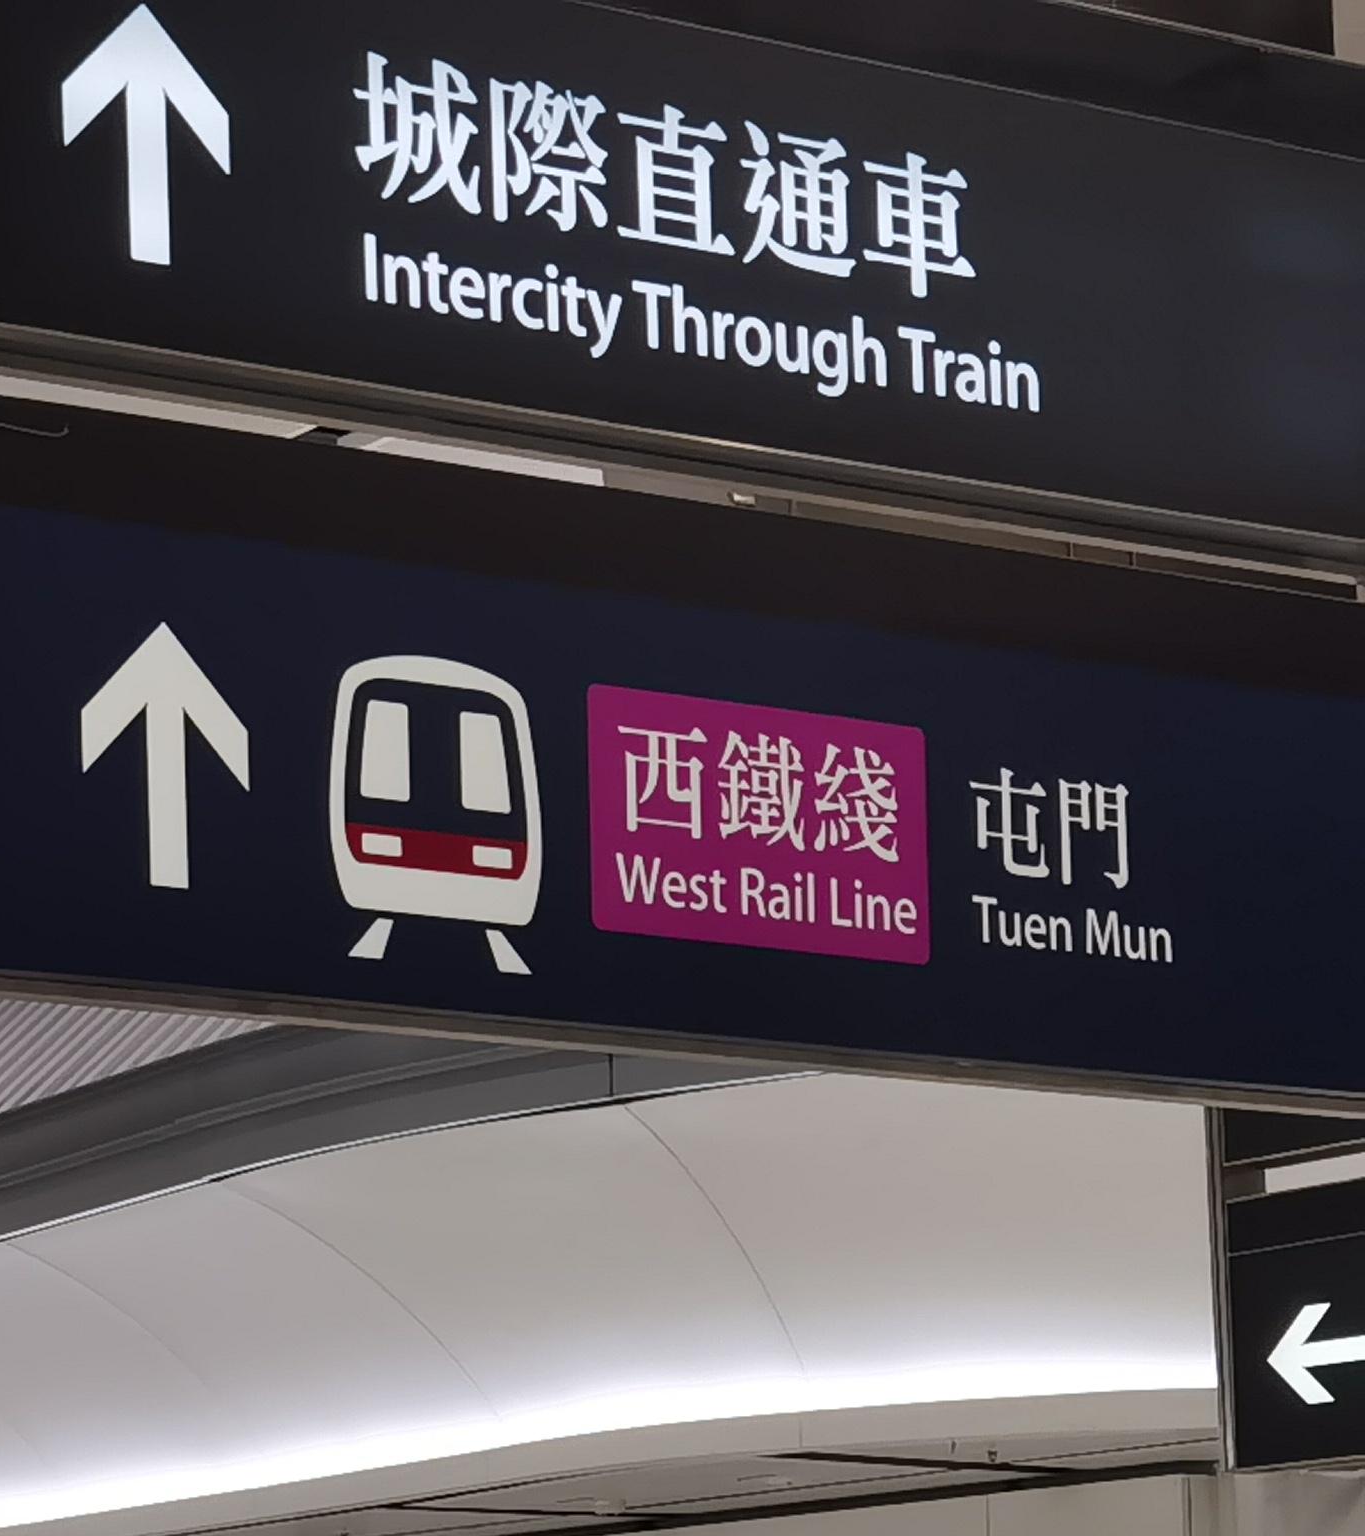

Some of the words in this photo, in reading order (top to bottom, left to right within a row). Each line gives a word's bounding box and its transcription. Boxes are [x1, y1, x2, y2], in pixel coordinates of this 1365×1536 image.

[353, 52, 976, 297] 城際直通車
[364, 233, 622, 358] Intercity
[632, 280, 887, 397] Through
[898, 326, 1039, 412] Train
[970, 768, 1129, 888] 屯門
[616, 853, 727, 913] West
[741, 868, 814, 923] Rail
[830, 878, 917, 934] Line
[972, 895, 1072, 951] Tuen
[1086, 908, 1172, 962] Mun
